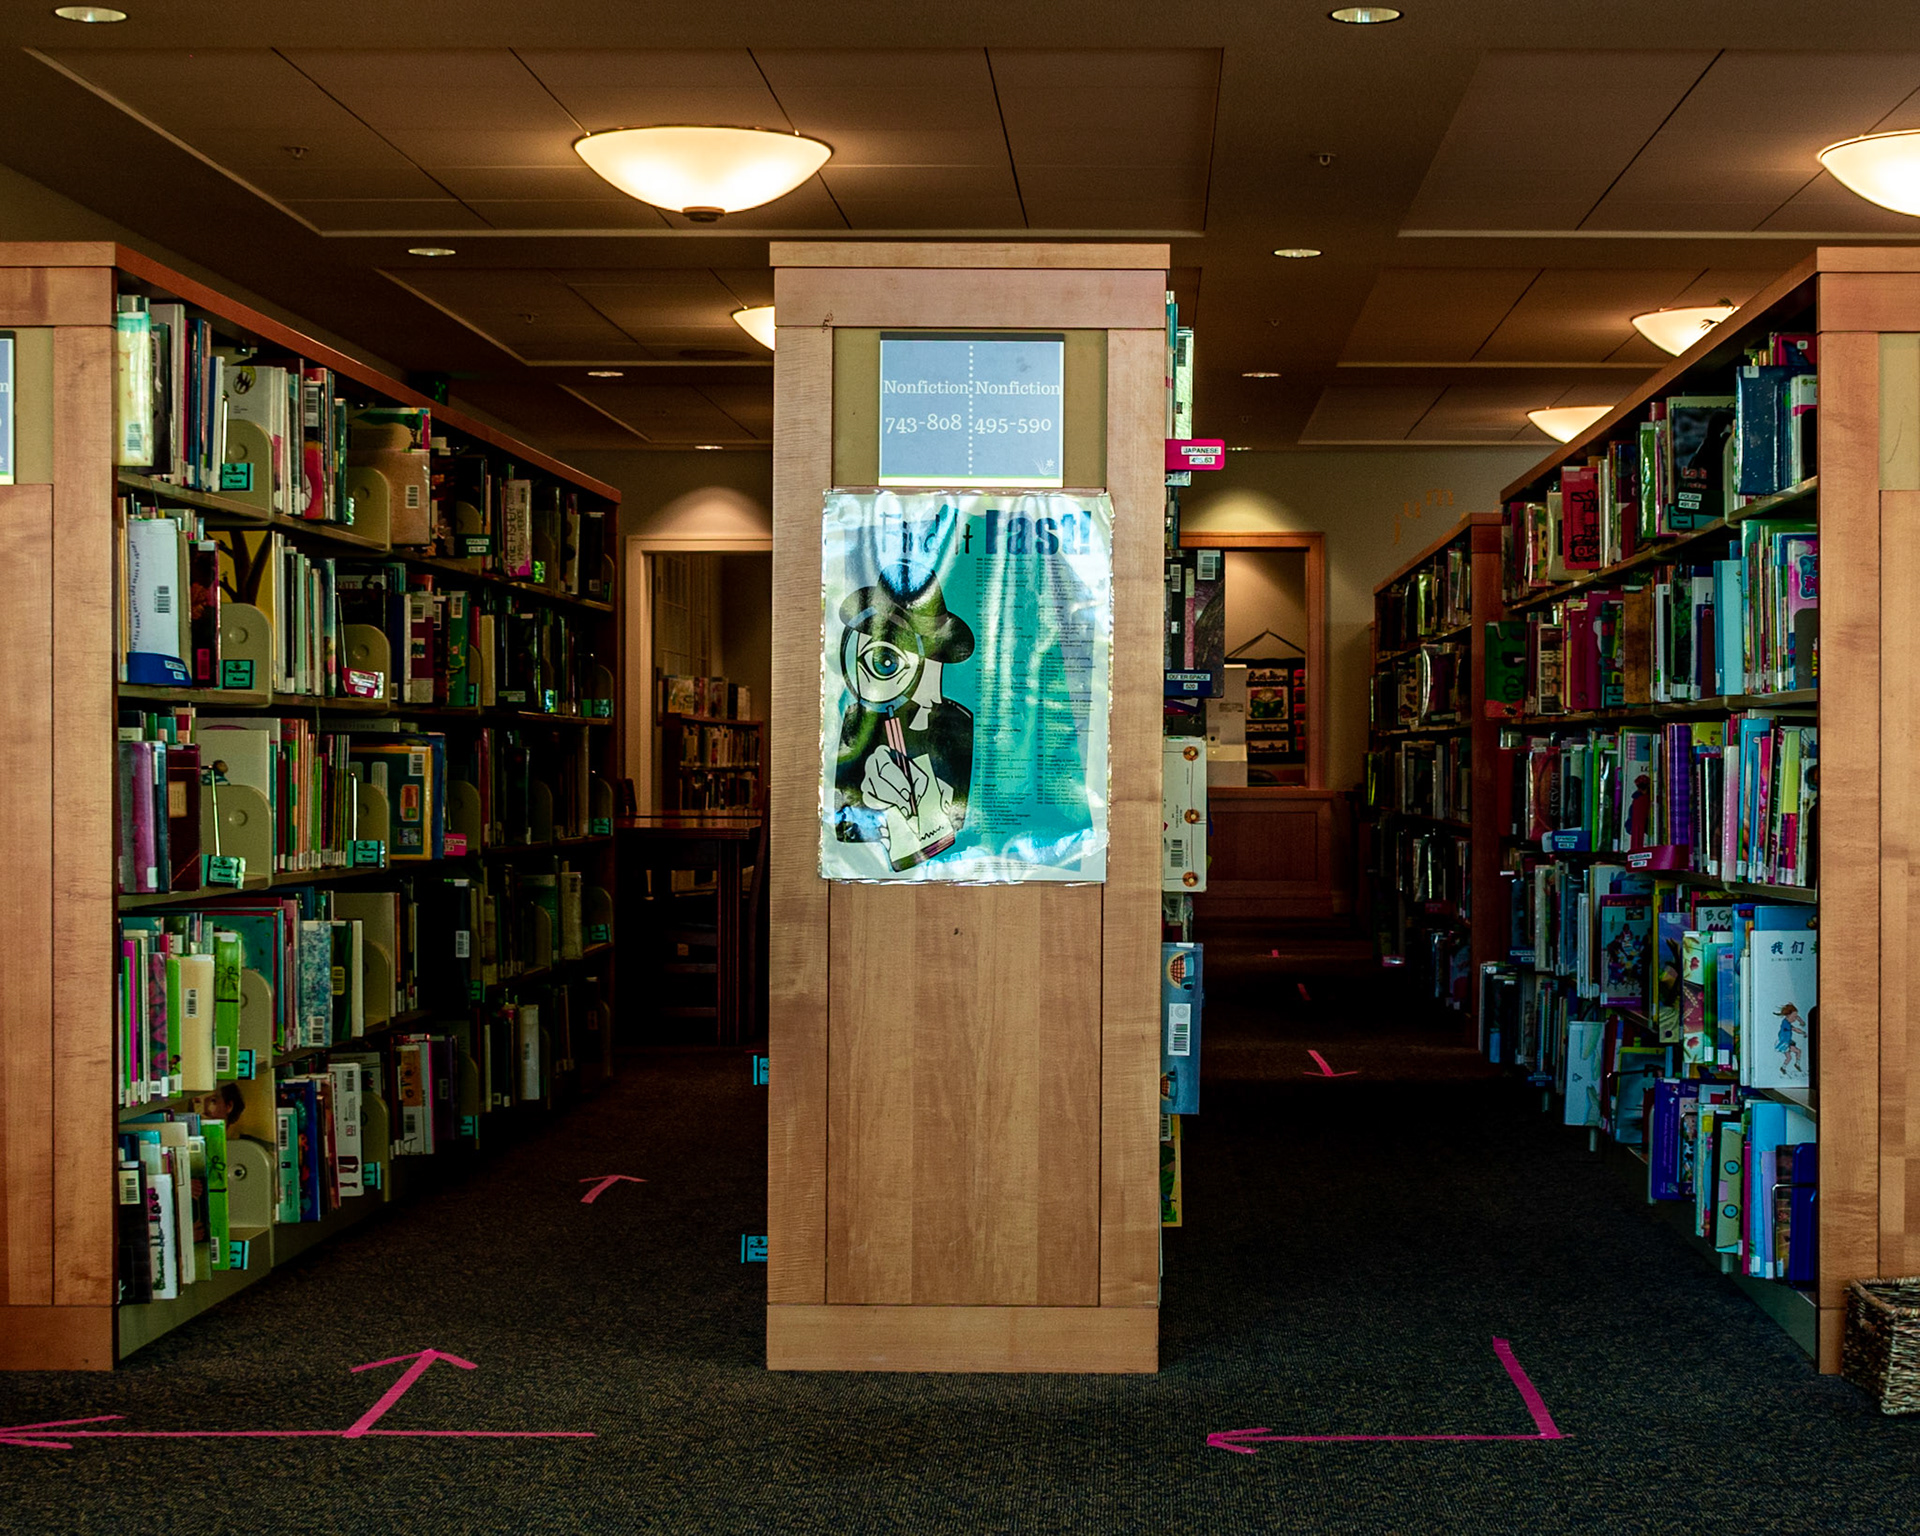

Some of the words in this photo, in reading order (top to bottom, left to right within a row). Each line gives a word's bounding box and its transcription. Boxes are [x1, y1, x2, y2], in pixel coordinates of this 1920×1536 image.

[883, 380, 970, 395] Nonfiction
[975, 381, 1061, 395] Nonfiction
[885, 413, 963, 434] 743-808
[974, 418, 1052, 434] 495-590
[985, 510, 1092, 555] Fast!
